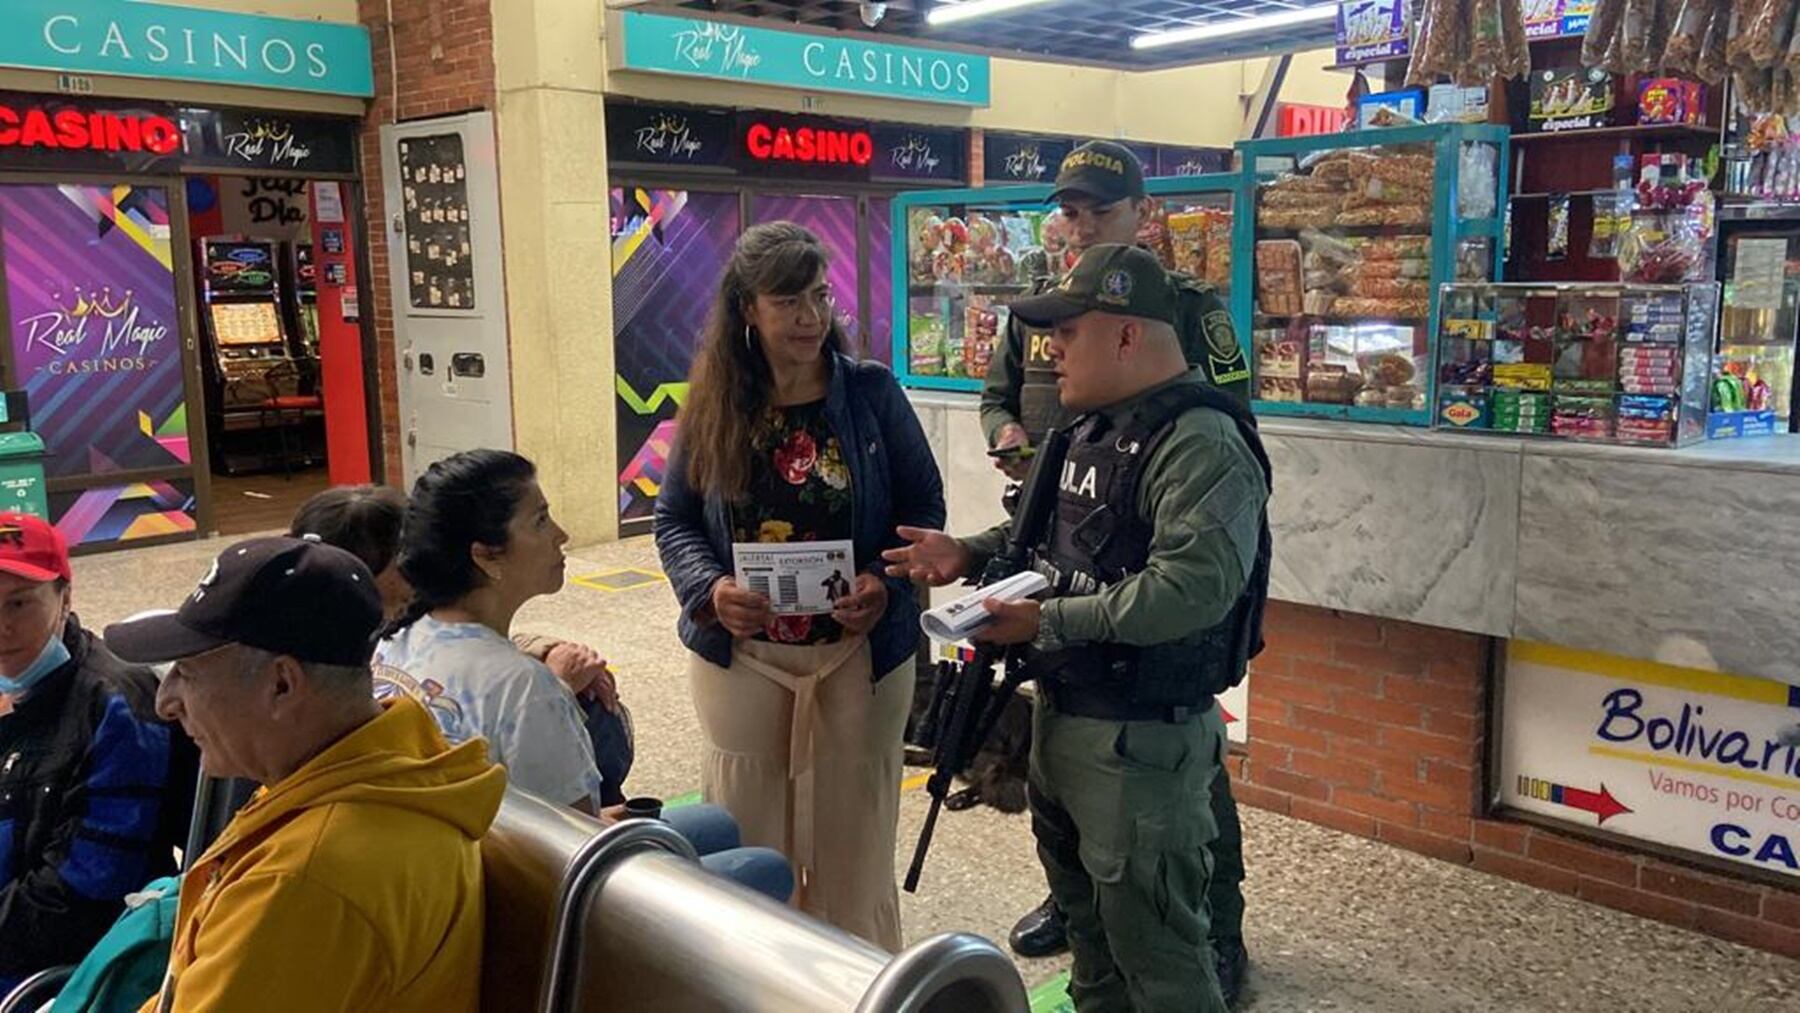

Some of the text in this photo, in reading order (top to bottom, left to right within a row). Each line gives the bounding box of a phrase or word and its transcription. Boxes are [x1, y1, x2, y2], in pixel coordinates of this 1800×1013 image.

[43, 15, 327, 78] CASINOS
[671, 30, 713, 69] Real
[803, 42, 970, 94] CASINOS
[1345, 42, 1391, 61] especial
[0, 105, 180, 154] CASINO
[224, 132, 311, 167] Real Magic
[747, 123, 873, 164] CASINO
[19, 306, 168, 356] Real Magic
[50, 357, 145, 375] CASINOS
[1648, 768, 1718, 803] Vamos
[1725, 791, 1763, 813] por
